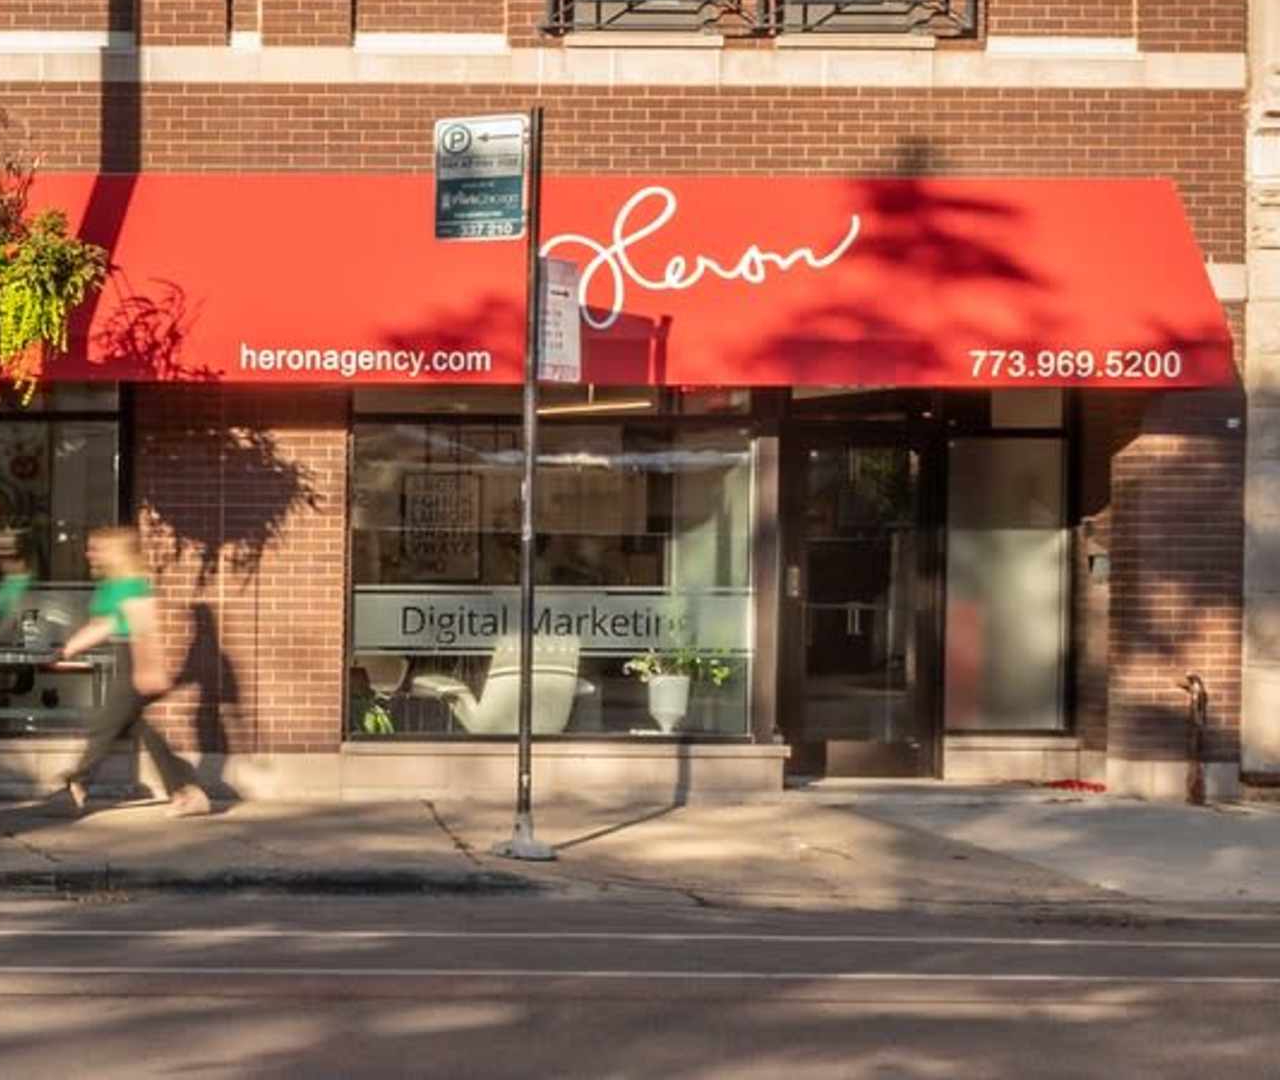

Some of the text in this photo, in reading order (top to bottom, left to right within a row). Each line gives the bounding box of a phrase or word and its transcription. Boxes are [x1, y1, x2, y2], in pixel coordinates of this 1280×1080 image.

[538, 186, 860, 329] Heron
[240, 343, 491, 377] heronagency.com
[969, 350, 1182, 377] 773.969.5200
[401, 605, 509, 644] Digital
